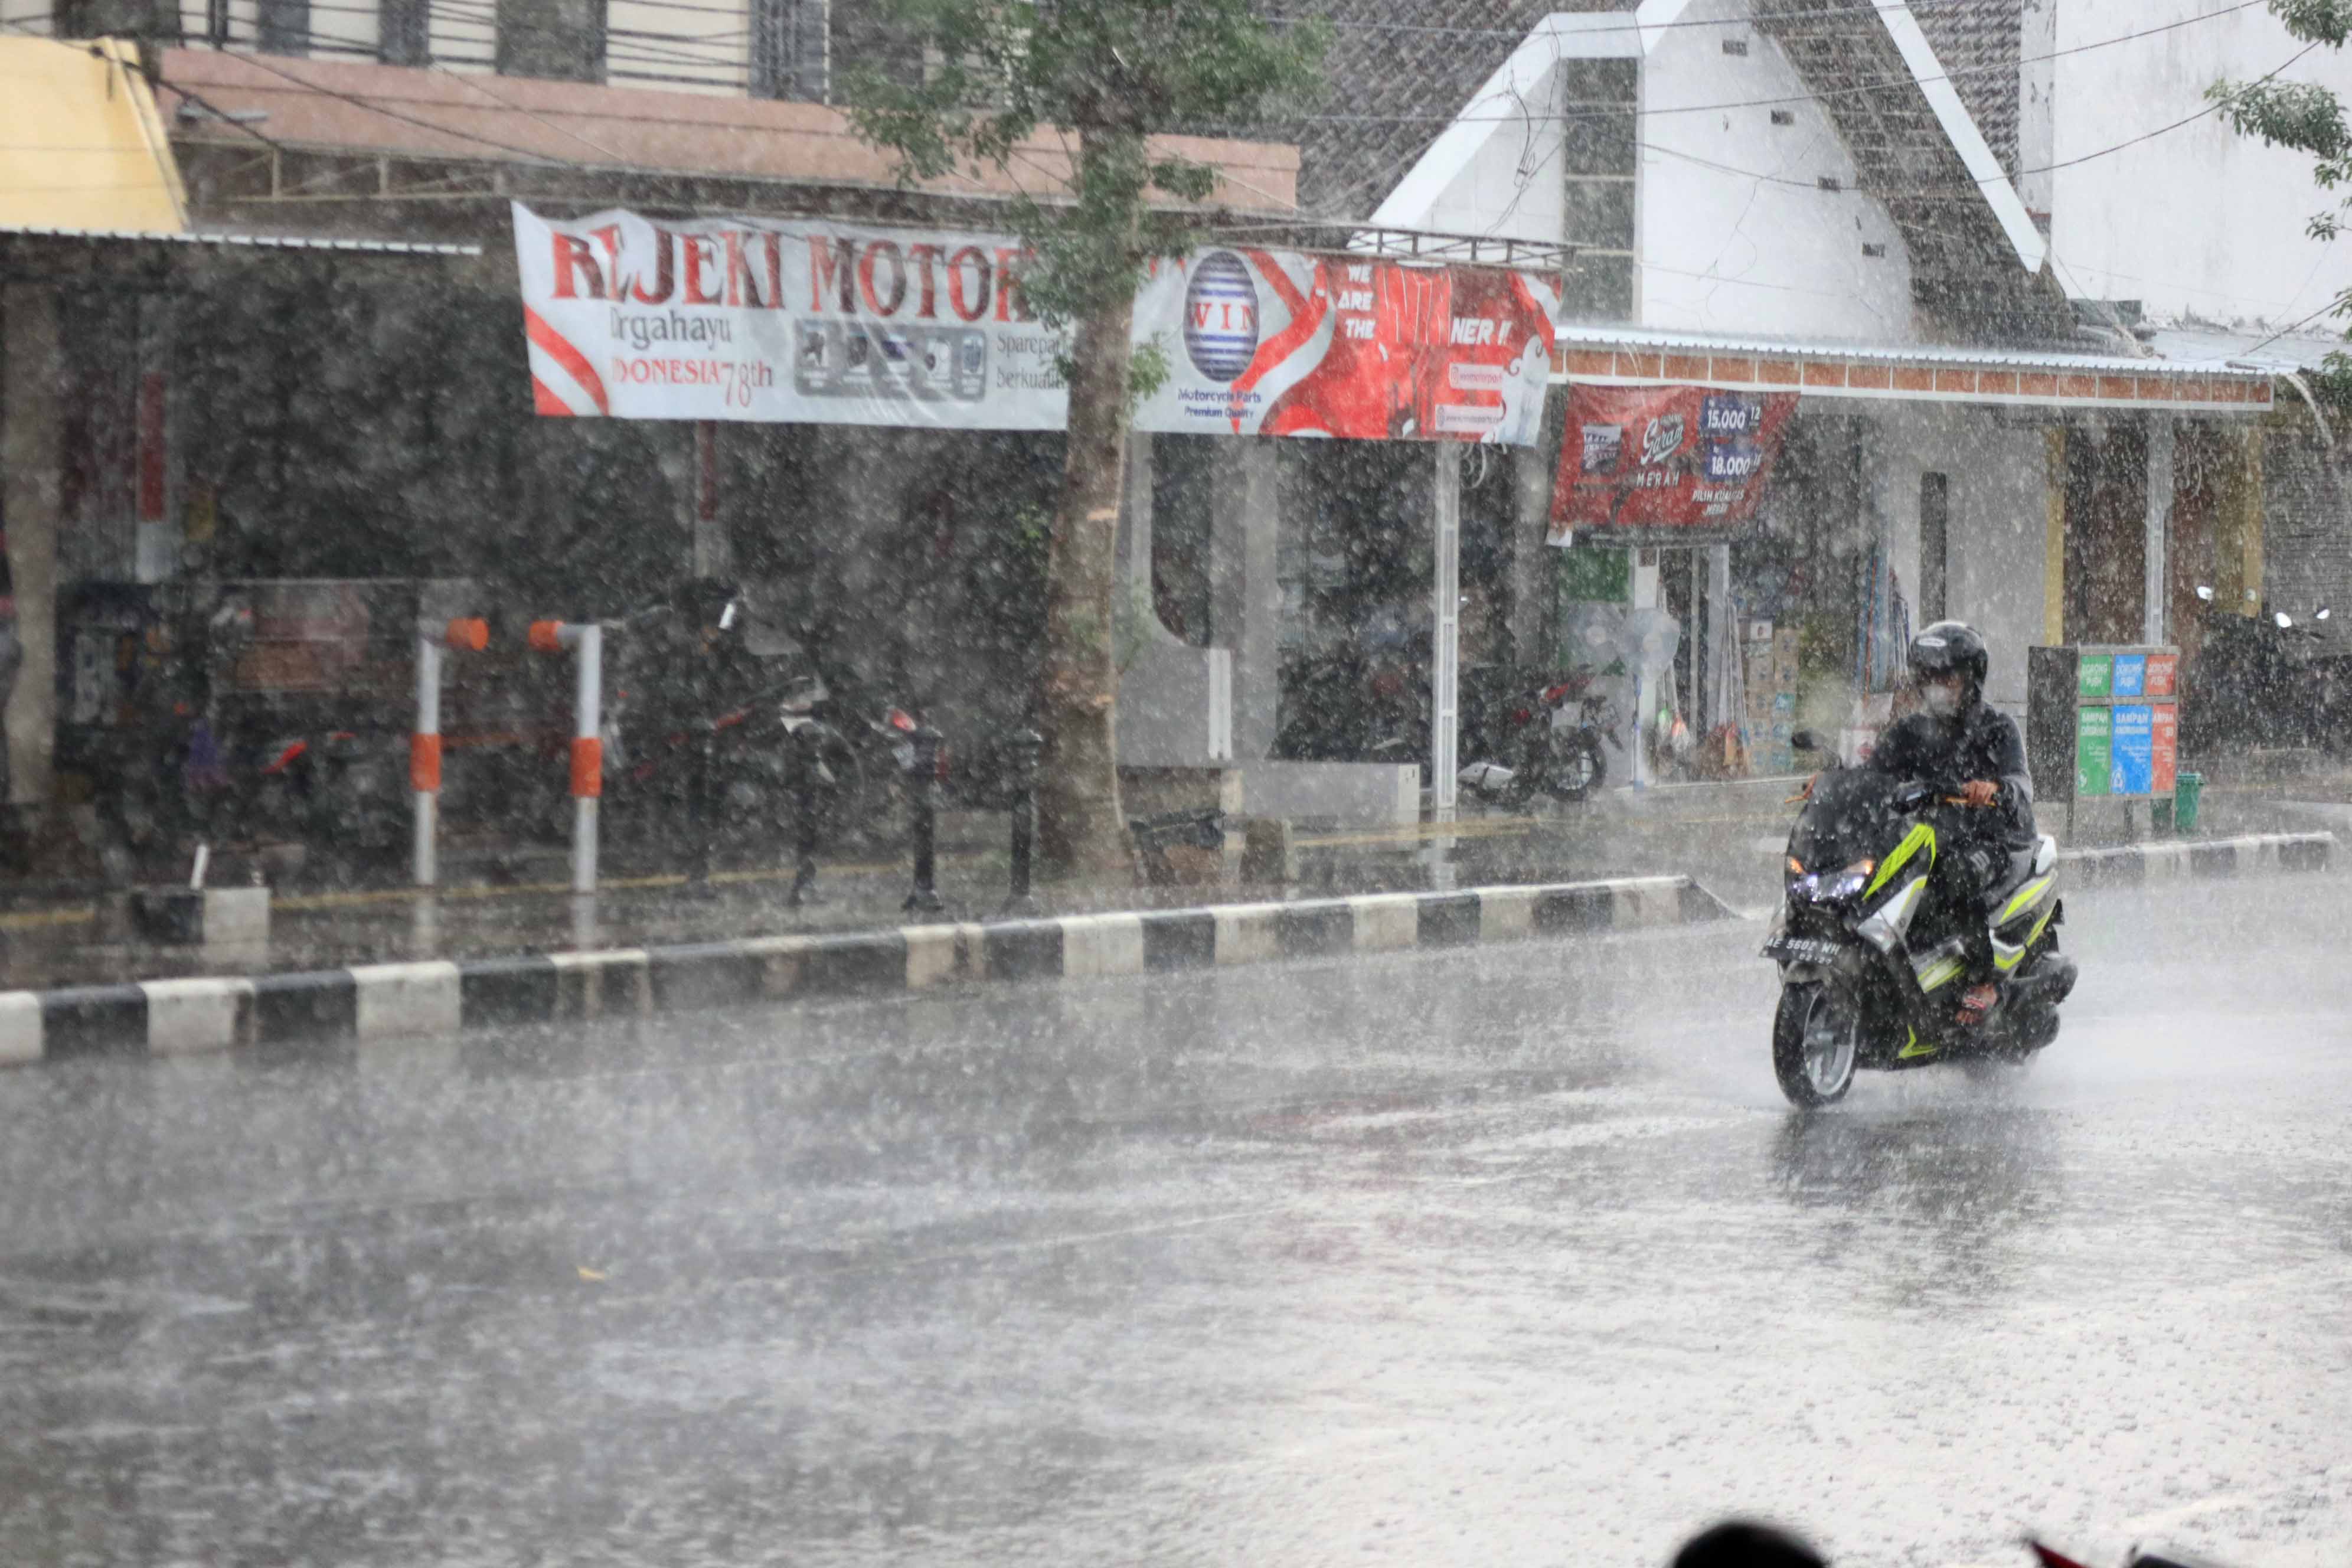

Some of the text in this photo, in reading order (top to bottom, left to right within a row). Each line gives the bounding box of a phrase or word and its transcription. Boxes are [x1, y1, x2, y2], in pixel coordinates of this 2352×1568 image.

[1347, 264, 1372, 283] WE
[1338, 290, 1373, 311] ARE
[1345, 318, 1376, 339] THE
[1178, 388, 1261, 403] Motorcycle Parts
[1185, 406, 1254, 419] Premium Quality
[1707, 410, 1746, 429] 15.000
[1712, 456, 1750, 475] 18.000
[1636, 471, 1680, 486] MERAH
[2152, 713, 2174, 723] AMPAH
